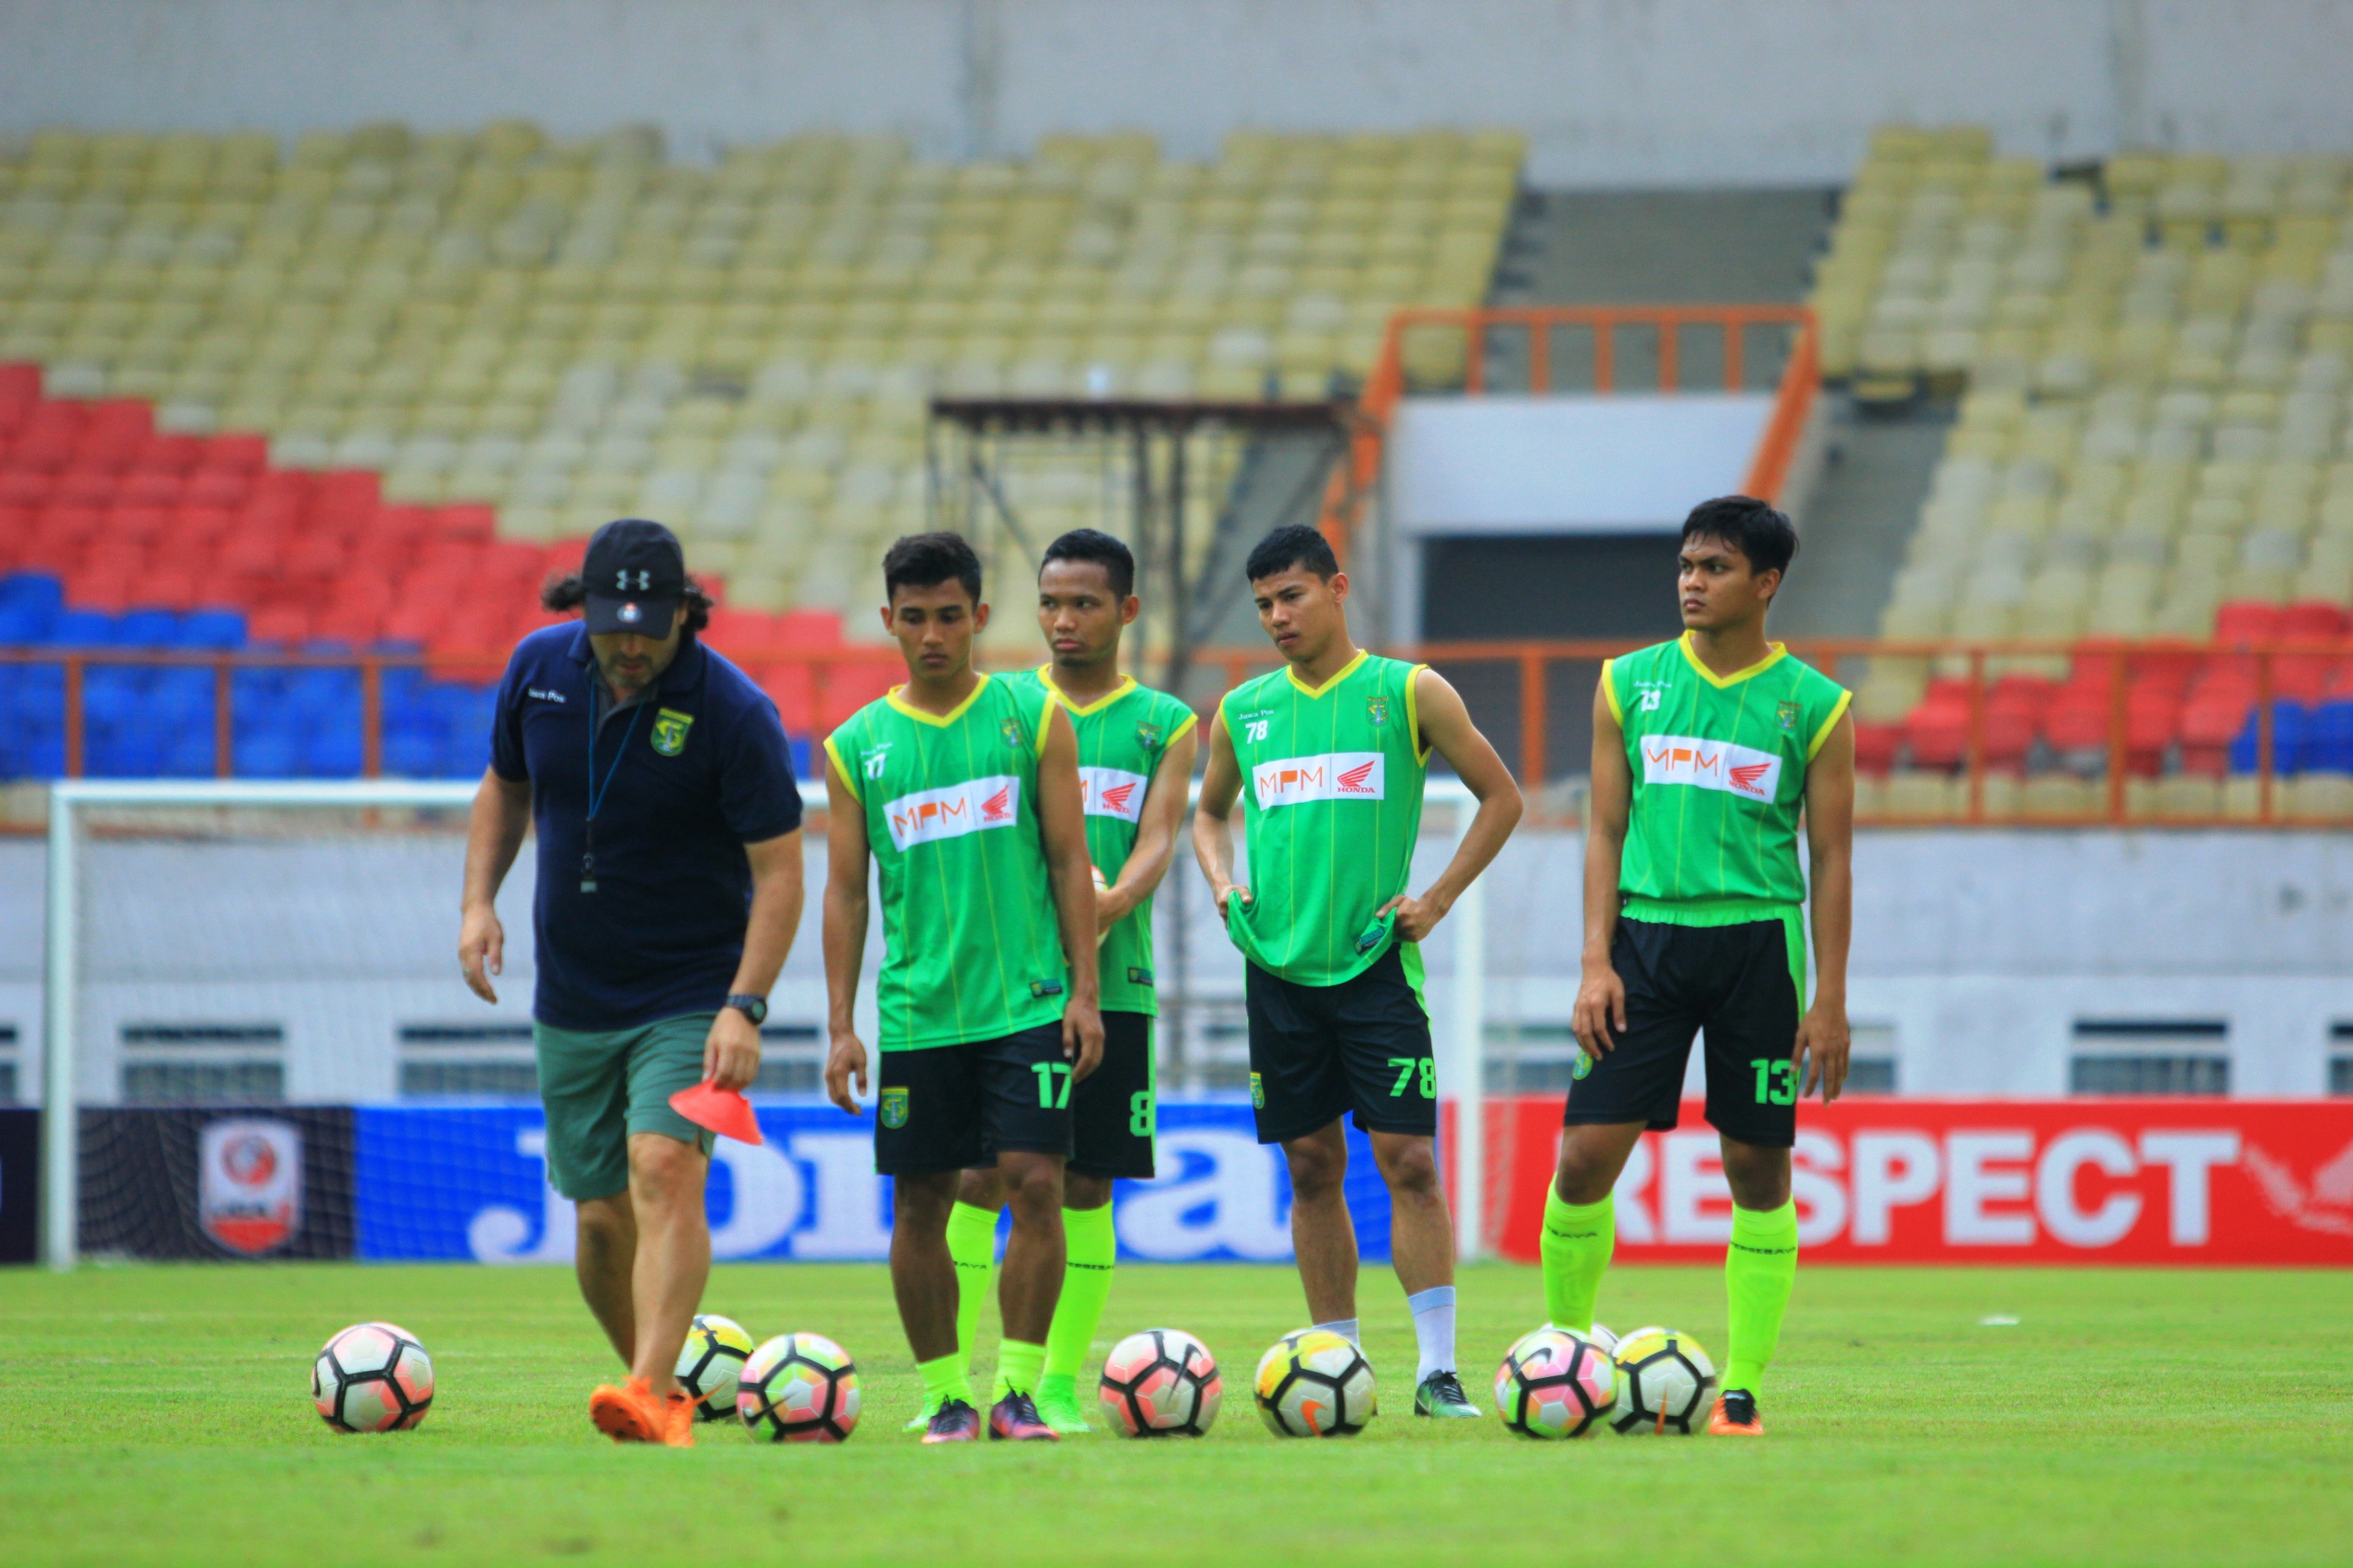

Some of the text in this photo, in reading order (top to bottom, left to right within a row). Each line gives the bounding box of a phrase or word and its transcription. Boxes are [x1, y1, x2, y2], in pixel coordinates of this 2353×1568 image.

[1239, 712, 1259, 721] Jawa
[1245, 720, 1268, 745] 78
[864, 753, 887, 780] 17
[1647, 748, 1718, 777] MPM
[1260, 766, 1323, 798] MPM
[892, 797, 967, 837] MPM
[984, 812, 1013, 822] HOND
[1102, 803, 1131, 814] HOND
[1031, 1061, 1074, 1110] 17
[1388, 1057, 1436, 1099] 78
[1750, 1059, 1797, 1106] 13
[1129, 1090, 1152, 1137] 8
